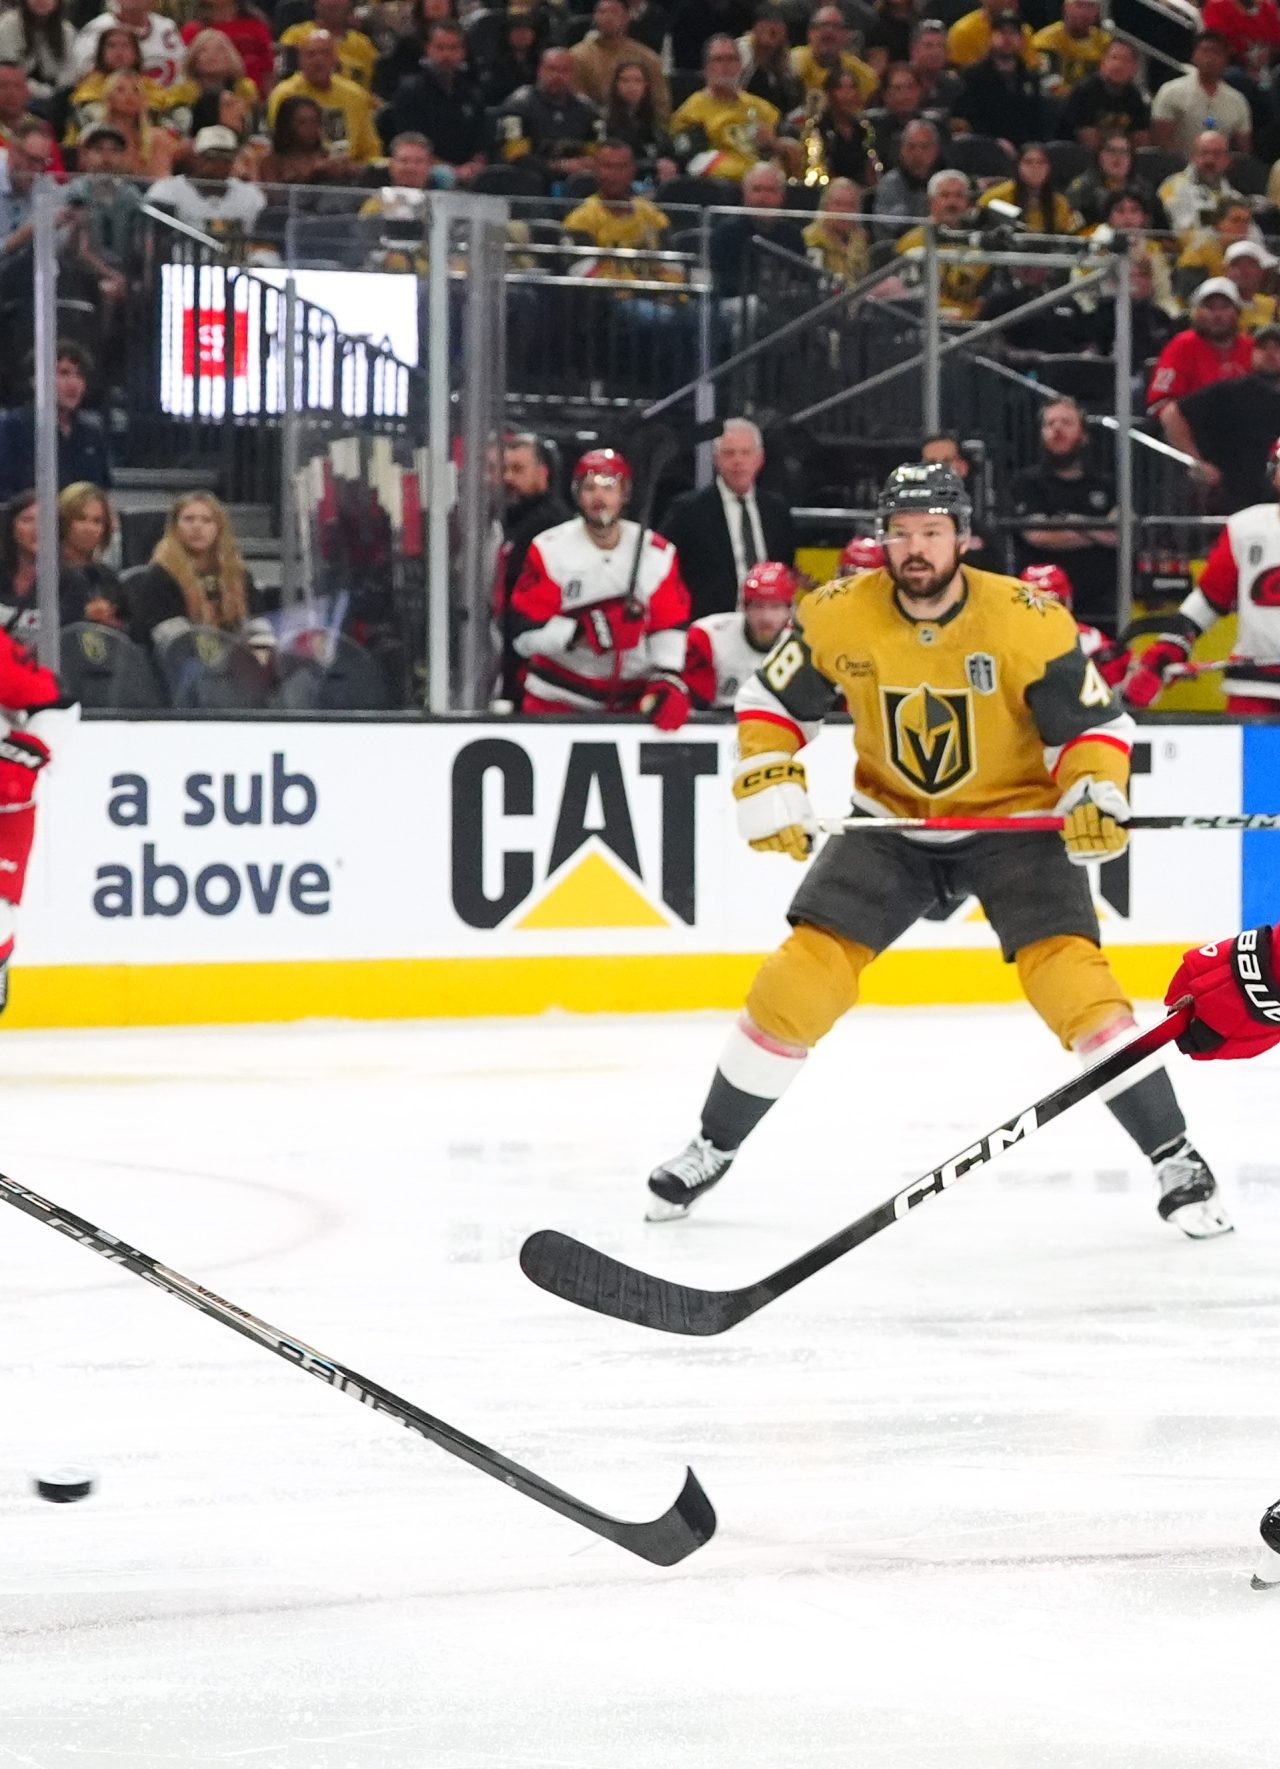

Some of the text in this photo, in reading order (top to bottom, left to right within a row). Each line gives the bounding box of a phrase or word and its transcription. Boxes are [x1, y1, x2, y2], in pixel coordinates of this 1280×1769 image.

[108, 753, 316, 826] a sub
[743, 767, 806, 789] CCM
[452, 739, 717, 928] CAT
[94, 844, 330, 917] above
[894, 1106, 1038, 1221] CCM
